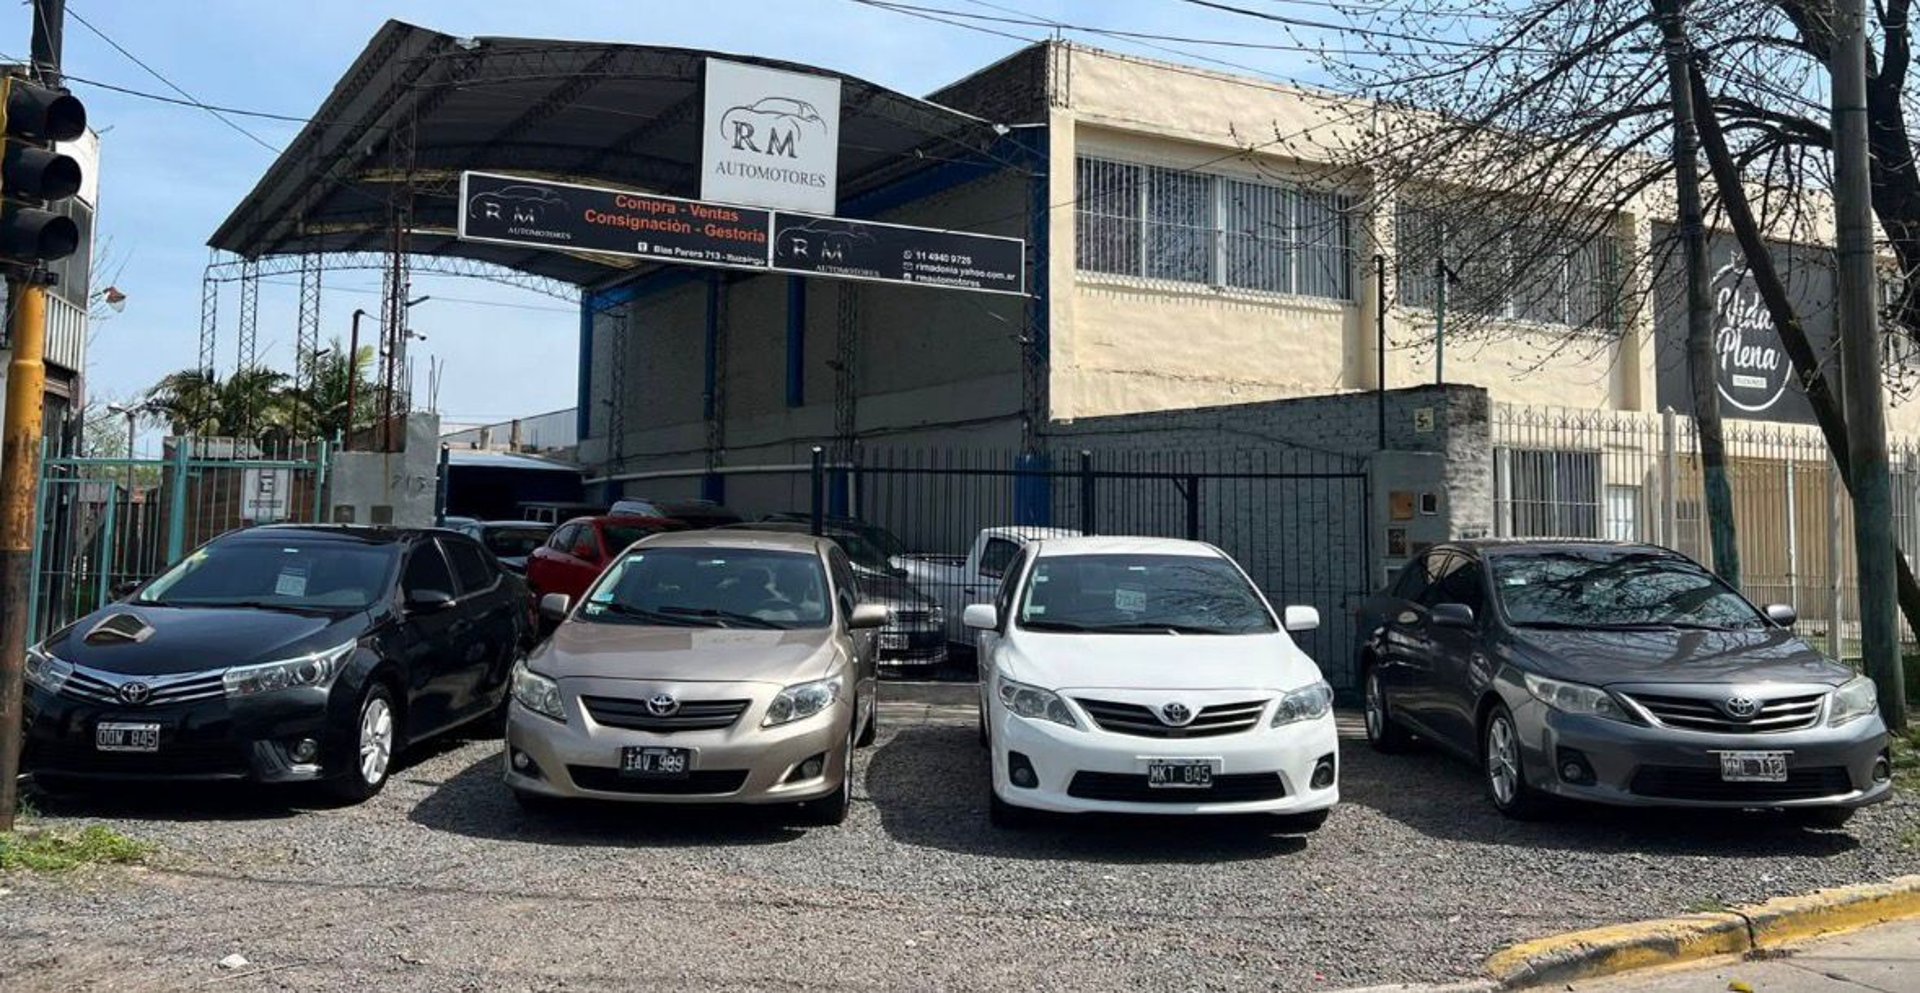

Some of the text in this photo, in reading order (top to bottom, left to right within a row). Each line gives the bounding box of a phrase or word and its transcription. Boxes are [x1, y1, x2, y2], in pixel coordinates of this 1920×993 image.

[716, 161, 826, 188] AUTOMOTORES
[615, 194, 676, 214] Compra
[690, 204, 739, 222] Ventas
[508, 227, 571, 240] AUTOMOTORES
[654, 245, 672, 255] Blas
[674, 247, 703, 258] Parera
[705, 250, 720, 260] 713
[916, 251, 926, 260] 11
[1718, 287, 1774, 330] Vida
[1716, 326, 1781, 371] Plena
[131, 730, 156, 746] 845
[1150, 765, 1209, 783] MKT 845
